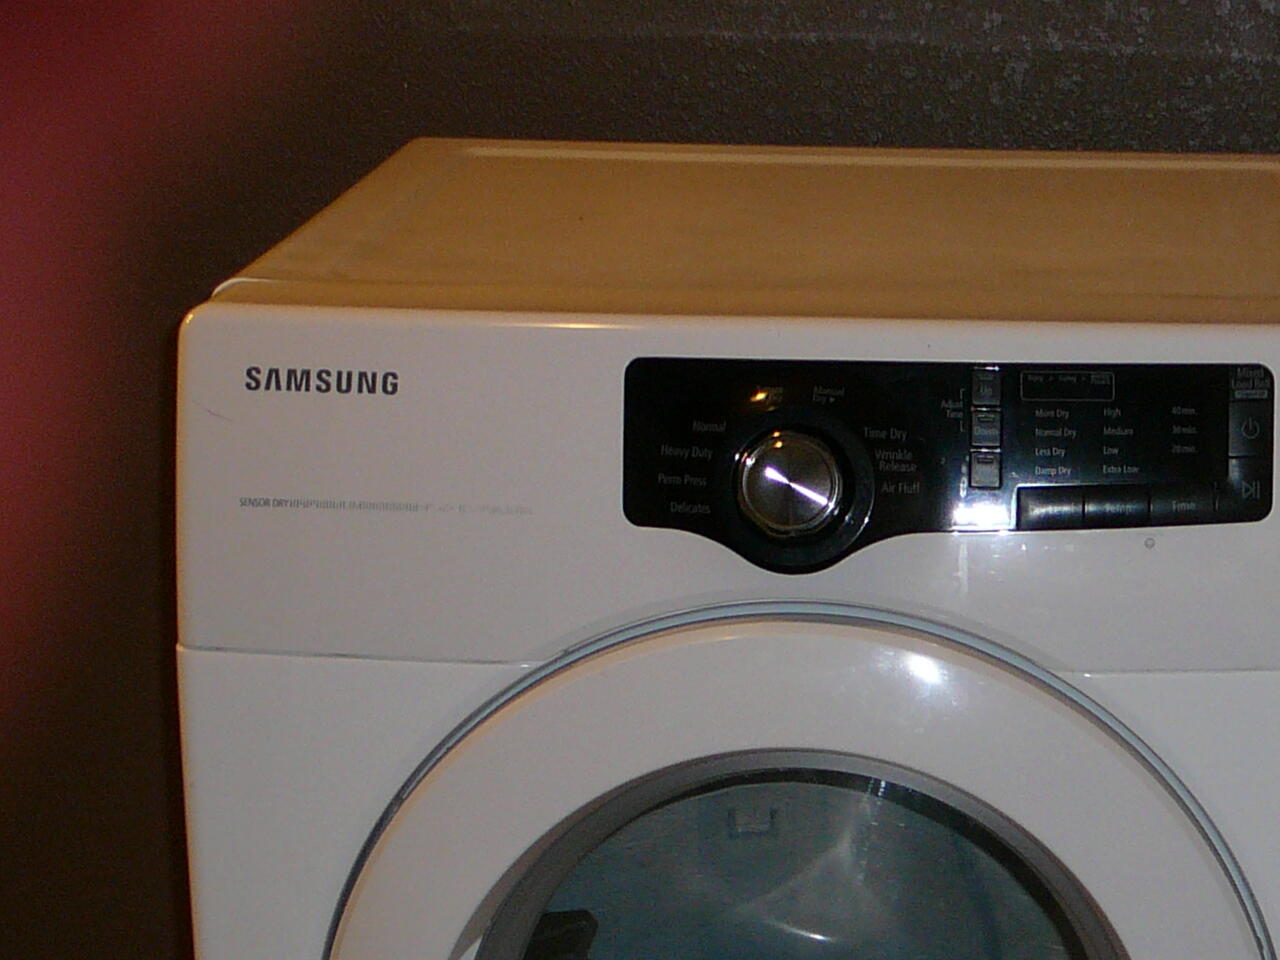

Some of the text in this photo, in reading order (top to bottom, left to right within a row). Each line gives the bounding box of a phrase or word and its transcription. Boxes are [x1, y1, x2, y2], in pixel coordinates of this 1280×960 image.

[245, 366, 399, 396] SAMSUNG
[1056, 408, 1070, 420] Dry
[1103, 407, 1122, 419] High
[692, 420, 727, 433] Normal
[864, 427, 909, 443] Time Dry
[1063, 428, 1078, 440] Dry
[660, 444, 714, 462] Heavy Duty
[1052, 447, 1066, 459] Dry
[1103, 446, 1120, 456] Low
[1058, 466, 1072, 478] Dry
[657, 472, 708, 487] Perm Press
[669, 500, 712, 515] Delicates
